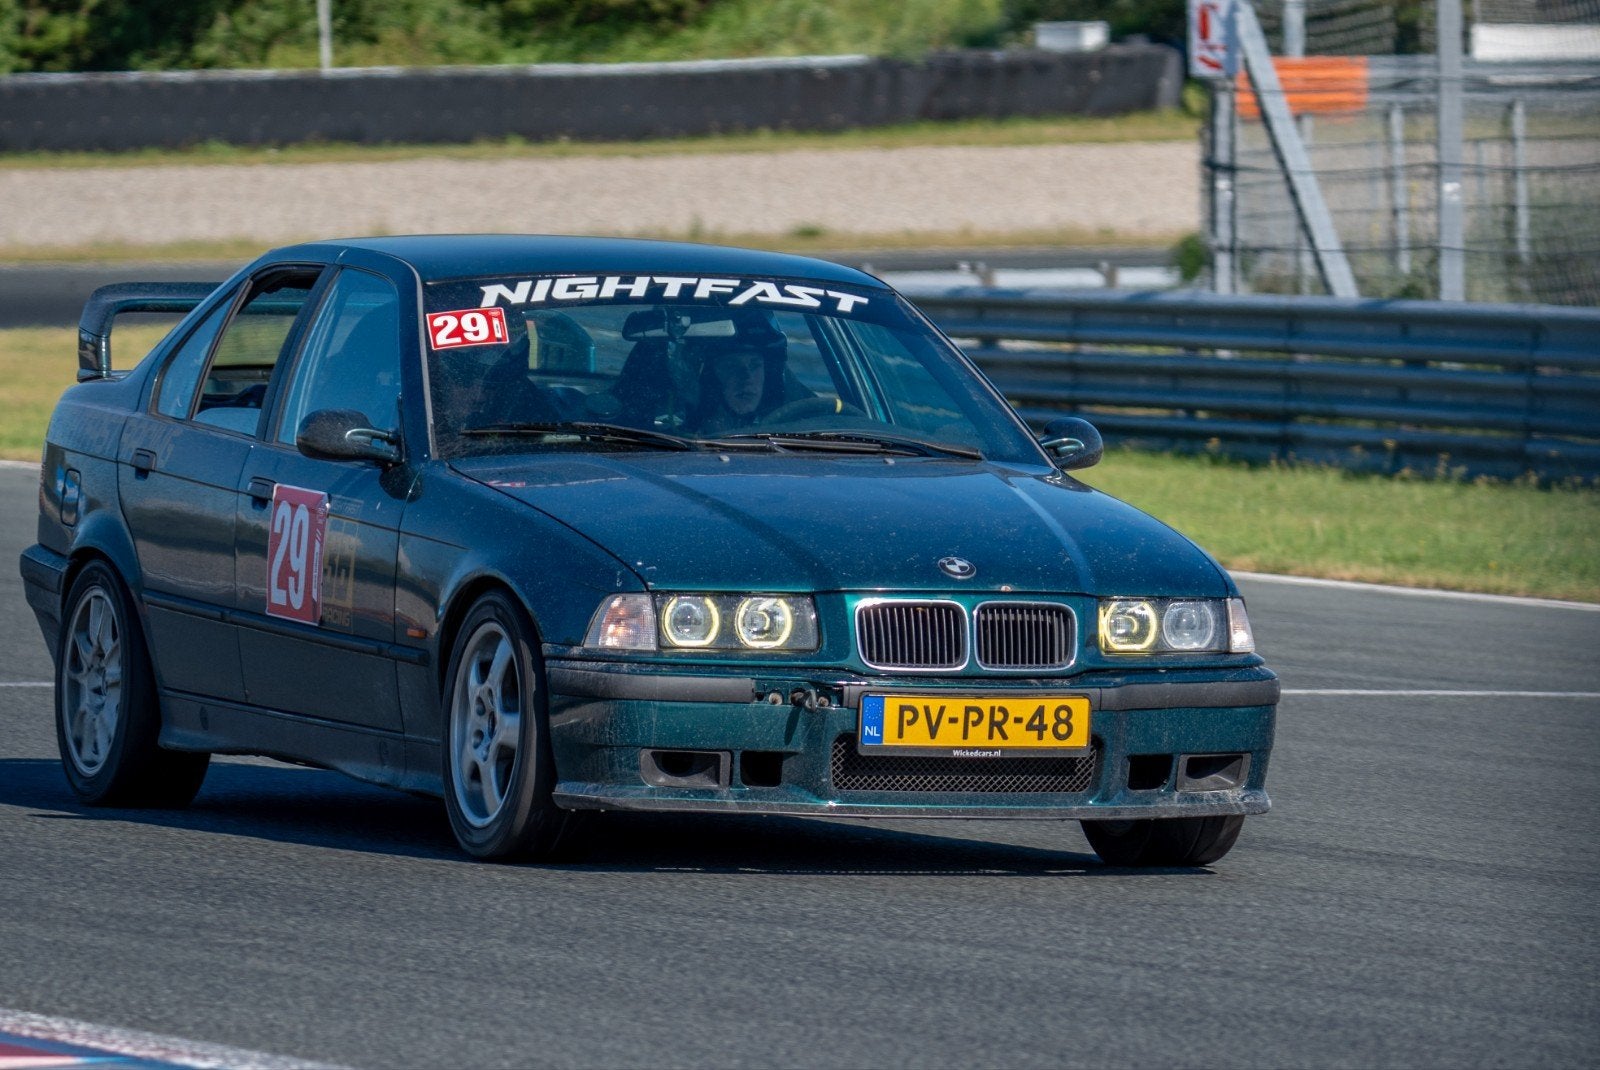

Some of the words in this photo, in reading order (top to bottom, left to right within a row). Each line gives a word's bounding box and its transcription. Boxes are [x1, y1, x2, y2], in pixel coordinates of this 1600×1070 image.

[480, 276, 868, 313] NIGHTFAST
[433, 313, 489, 345] 29
[271, 500, 309, 610] 29
[865, 726, 880, 737] NL
[897, 705, 1074, 741] PV-PR-48
[953, 749, 1001, 758] Wickedcars.nl
